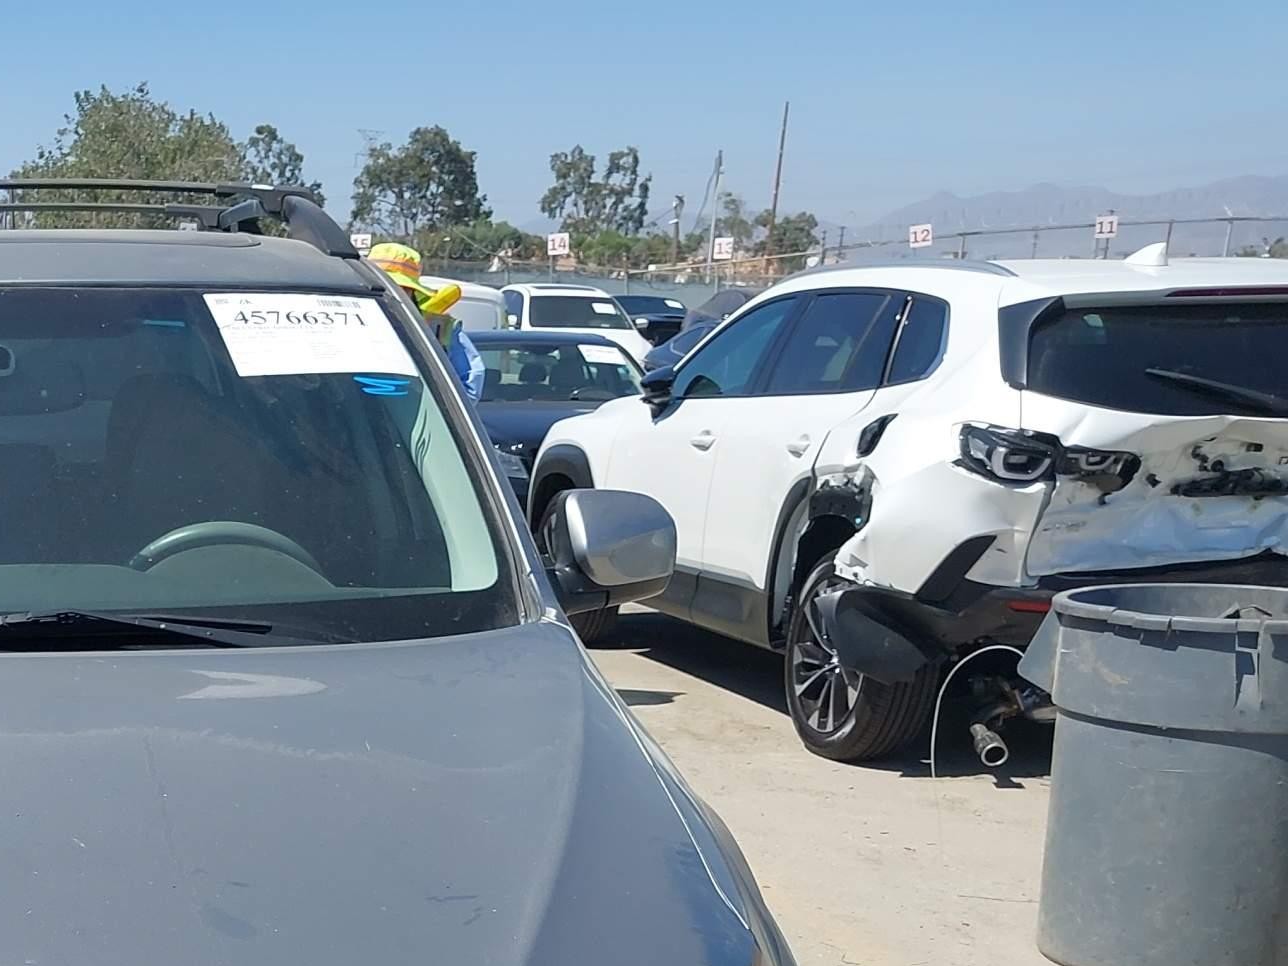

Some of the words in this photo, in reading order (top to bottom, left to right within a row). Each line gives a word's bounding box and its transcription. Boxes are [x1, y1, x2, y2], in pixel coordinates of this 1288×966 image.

[1097, 220, 1115, 234] 11
[911, 229, 930, 244] 12
[549, 238, 566, 251] 14
[717, 242, 733, 255] 13
[234, 310, 367, 327] 45766371
